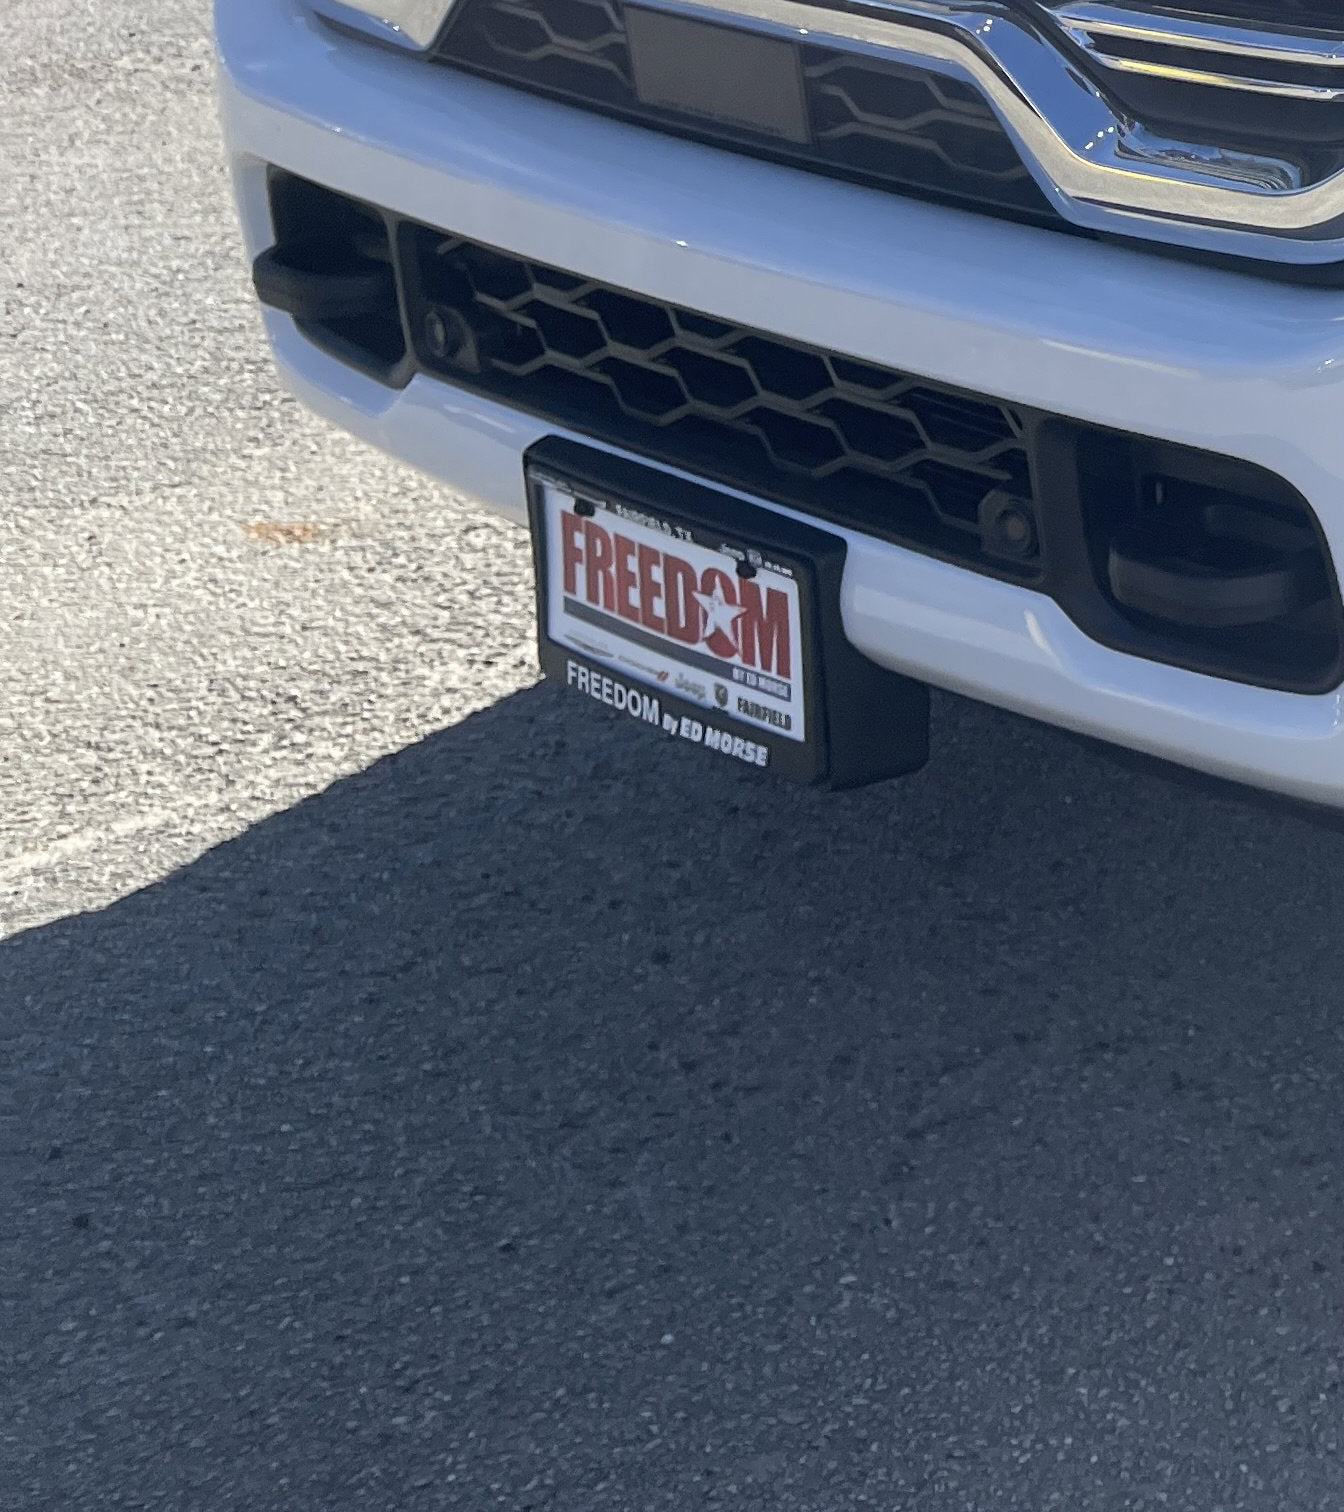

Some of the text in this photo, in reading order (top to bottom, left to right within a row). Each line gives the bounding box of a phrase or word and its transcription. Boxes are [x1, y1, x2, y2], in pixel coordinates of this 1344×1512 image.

[560, 509, 791, 680] FREEDOM
[567, 659, 660, 726] FREEDOM
[679, 715, 703, 743] ED
[704, 725, 768, 767] MORSE
